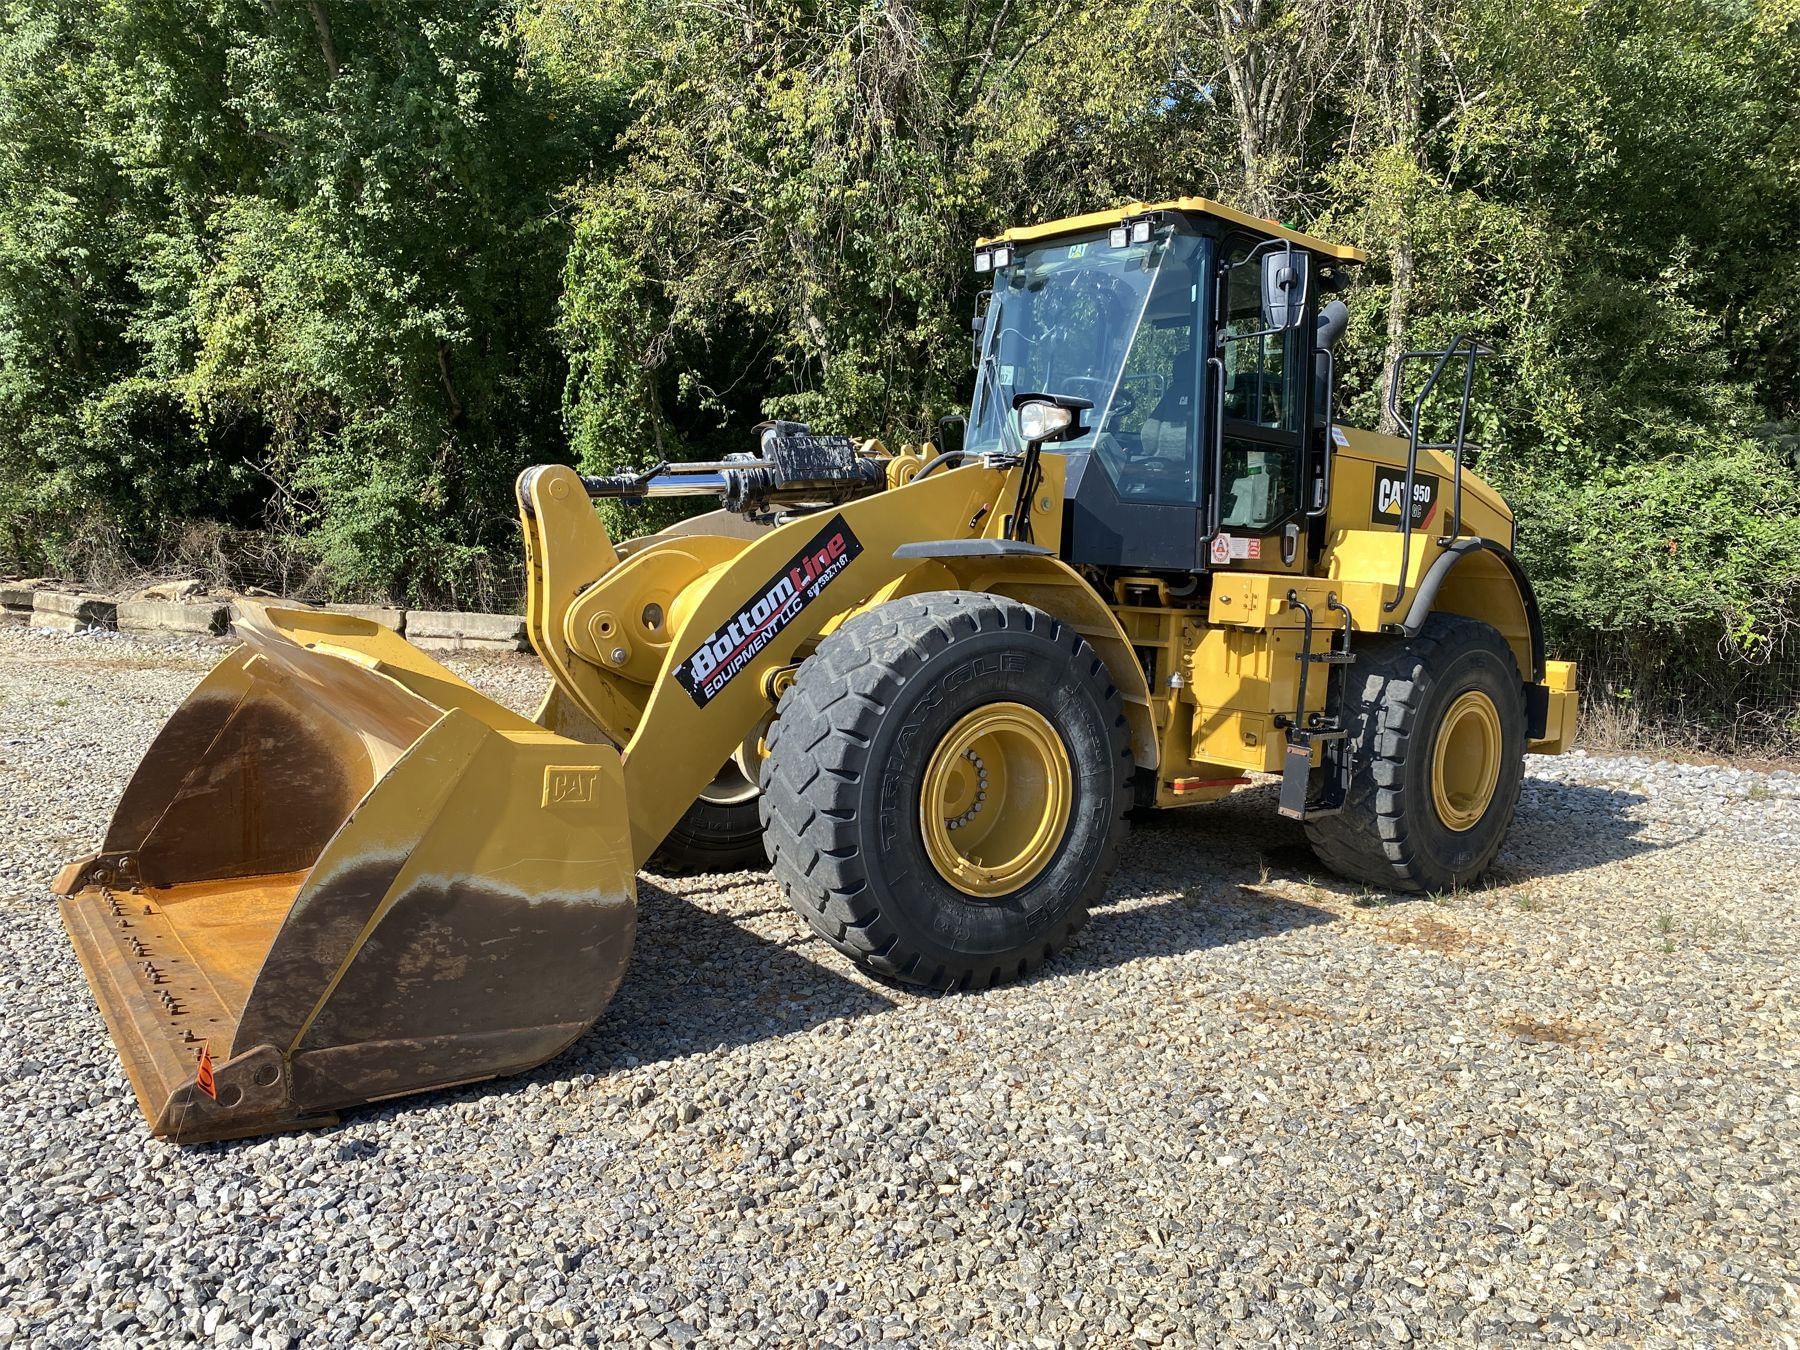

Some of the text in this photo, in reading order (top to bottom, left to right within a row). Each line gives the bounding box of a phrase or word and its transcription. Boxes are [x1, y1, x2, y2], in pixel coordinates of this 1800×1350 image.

[1068, 243, 1089, 259] CAT
[1413, 484, 1431, 503] 950
[704, 611, 784, 698] EQUIPMENT
[780, 597, 803, 625] LLC
[553, 773, 598, 803] CAT
